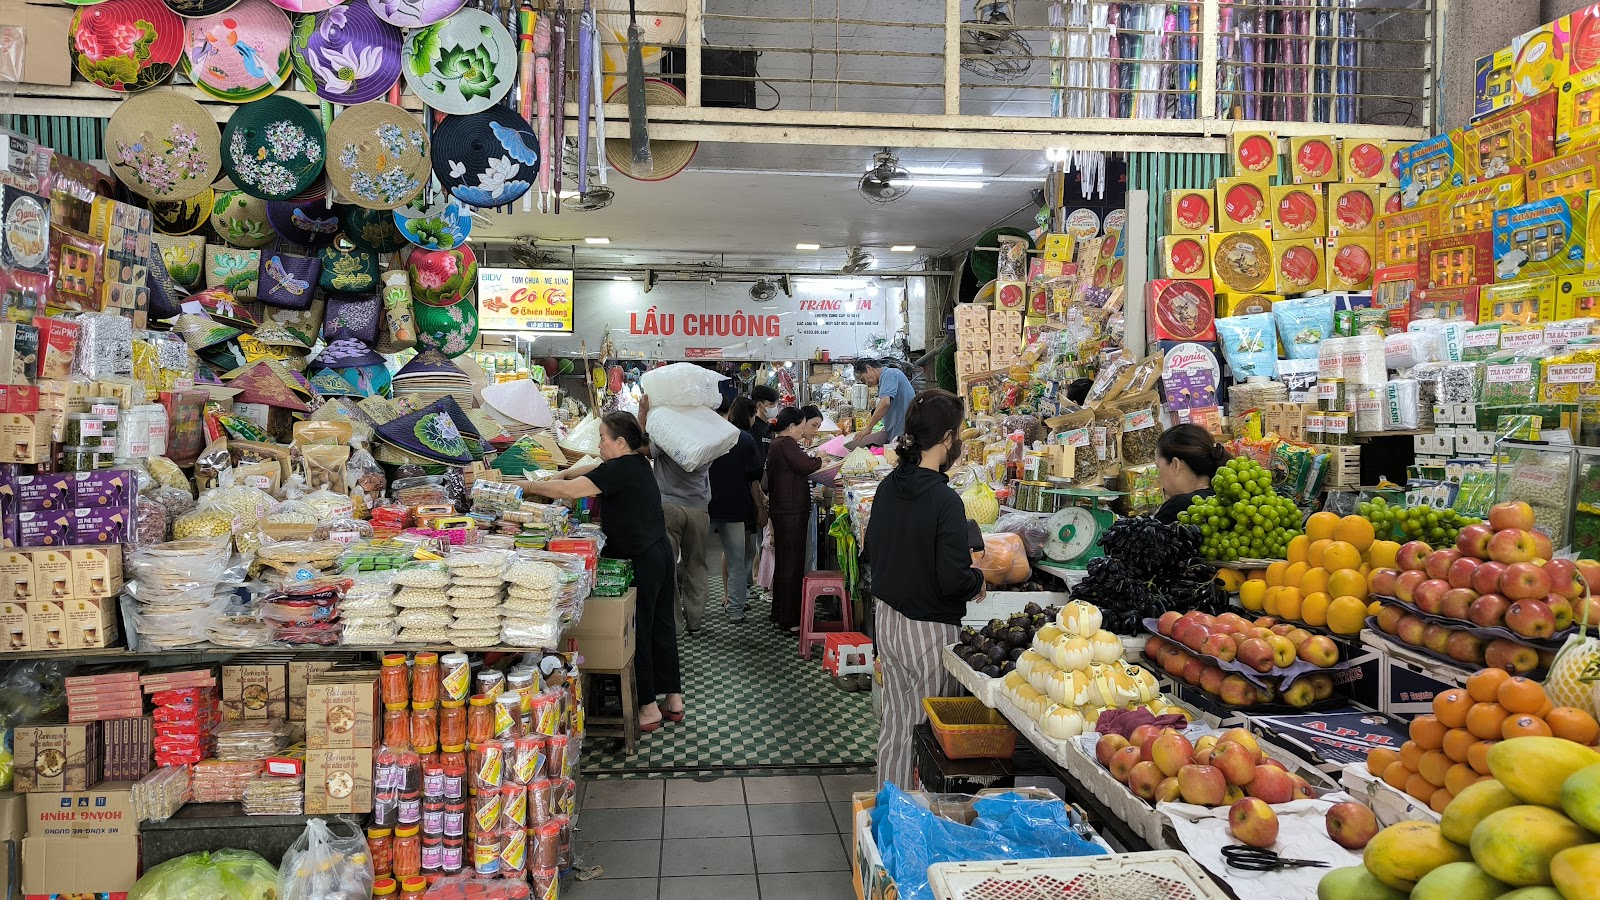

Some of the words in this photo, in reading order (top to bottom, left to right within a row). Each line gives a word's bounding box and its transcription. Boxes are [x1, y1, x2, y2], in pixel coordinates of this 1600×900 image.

[1241, 148, 1248, 156] LU
[1304, 145, 1311, 154] LU
[1282, 200, 1289, 209] LU
[1340, 198, 1348, 206] LU
[1226, 203, 1234, 212] LU
[1287, 250, 1295, 259] LU
[1342, 247, 1350, 257] LU
[1172, 255, 1180, 263] LU
[510, 288, 537, 303] Cô
[799, 300, 842, 311] TRANG
[630, 305, 675, 336] LẦU
[683, 310, 780, 336] CHUÔNG
[1170, 351, 1206, 368] Danisa
[40, 810, 76, 821] THỊNH
